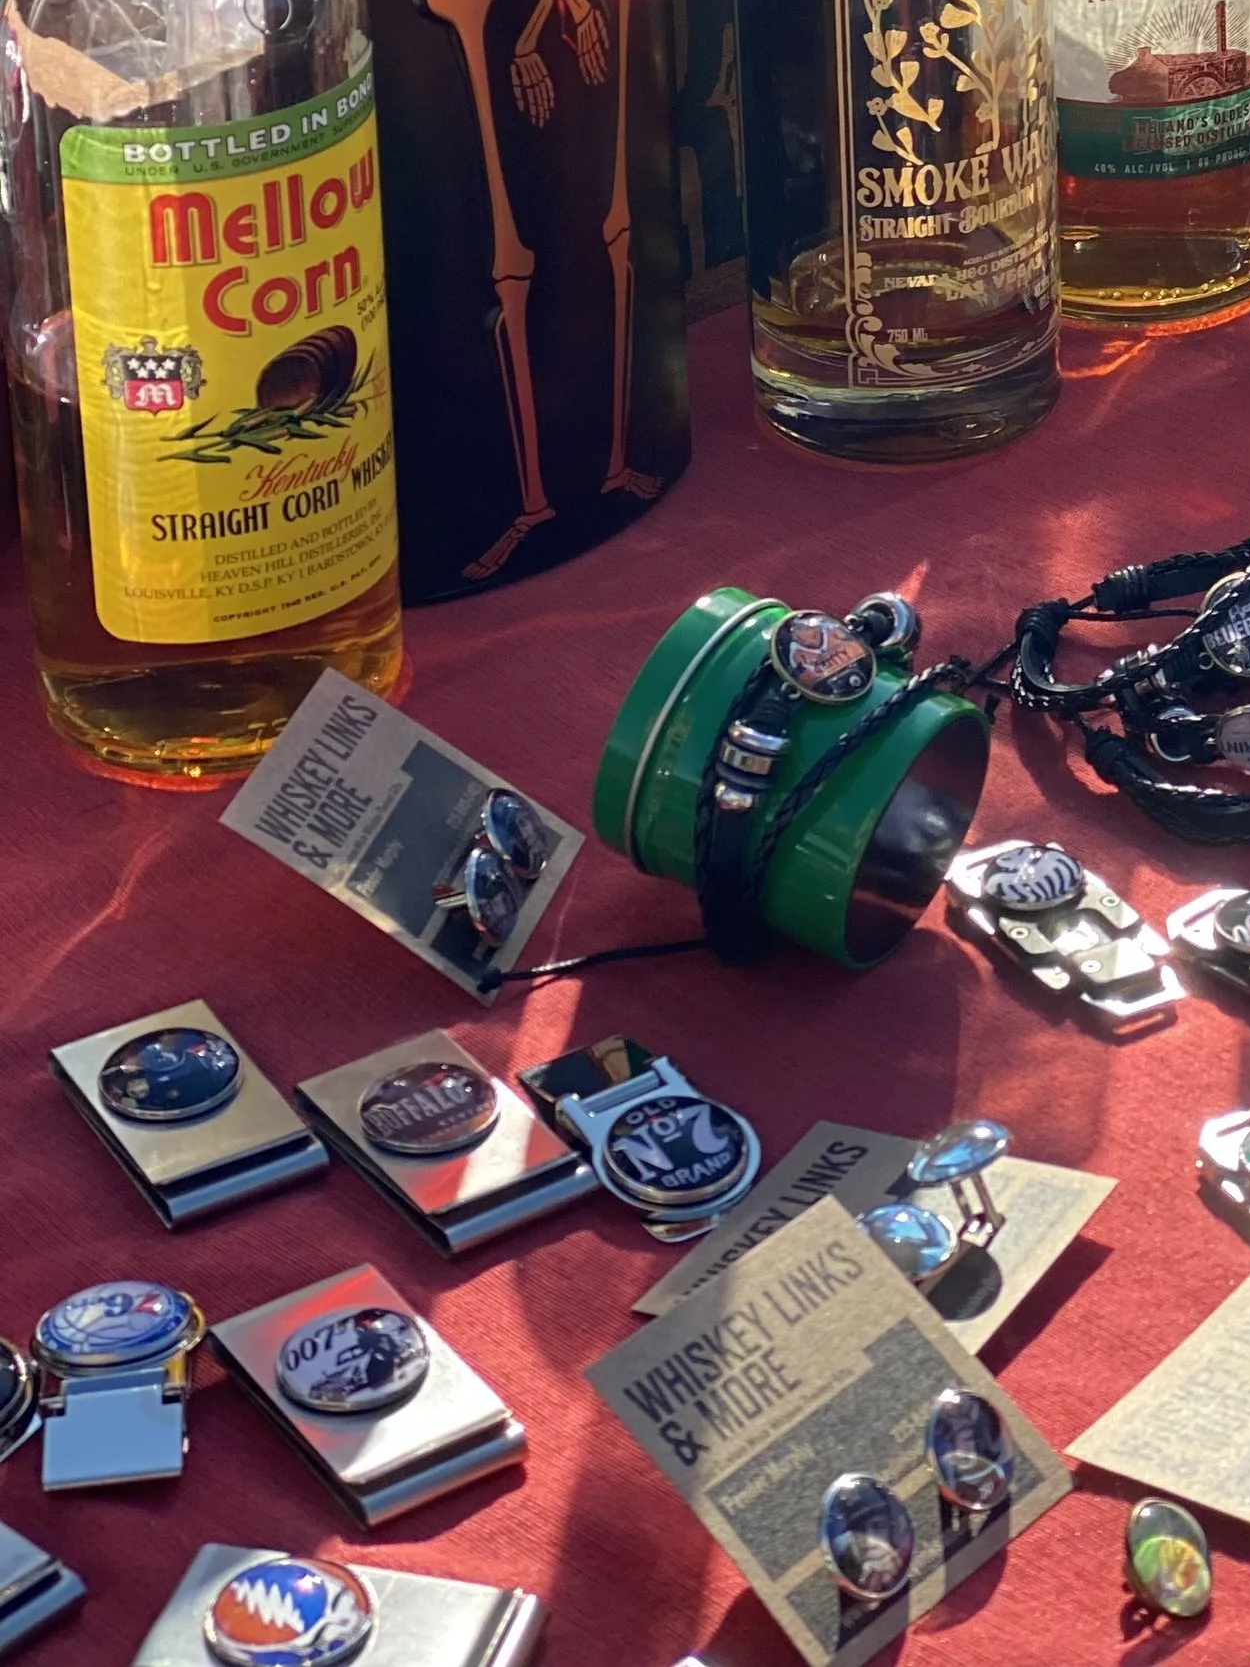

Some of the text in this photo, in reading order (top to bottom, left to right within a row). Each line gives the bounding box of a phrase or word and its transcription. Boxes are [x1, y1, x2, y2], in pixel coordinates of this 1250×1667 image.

[122, 123, 291, 164] BOTTLED
[302, 107, 328, 134] IN
[125, 132, 325, 177] UNDER U.S. GOVERNMENT
[149, 145, 375, 267] Mellow
[857, 154, 990, 208] SMOKE
[859, 212, 953, 242] STRAIGHT
[957, 183, 1035, 234] BOURBON
[202, 244, 362, 334] Corn
[887, 328, 908, 344] 750
[238, 435, 358, 504] Kentucky
[151, 501, 271, 542] STRAIGHT
[282, 478, 341, 523] CORN
[214, 540, 288, 566] DISTILLED
[289, 529, 320, 551] AND
[321, 506, 368, 538] BOTTLED
[200, 564, 262, 583] HEAVEN
[264, 556, 295, 577] HILL
[215, 583, 235, 598] KY
[276, 570, 298, 586] KY
[213, 605, 278, 623] COPYRIGHT
[254, 748, 339, 845] WHISKEY
[322, 695, 377, 763] LINKS
[292, 777, 374, 870] & MORE
[626, 1097, 677, 1125] OLD
[660, 1151, 732, 1188] BRAND
[787, 1140, 871, 1217] LINKS
[285, 1323, 336, 1372] 007
[623, 1313, 768, 1424] WHISKEY
[764, 1240, 865, 1326] LINKS
[659, 1420, 710, 1466] &
[693, 1346, 800, 1442] MORE
